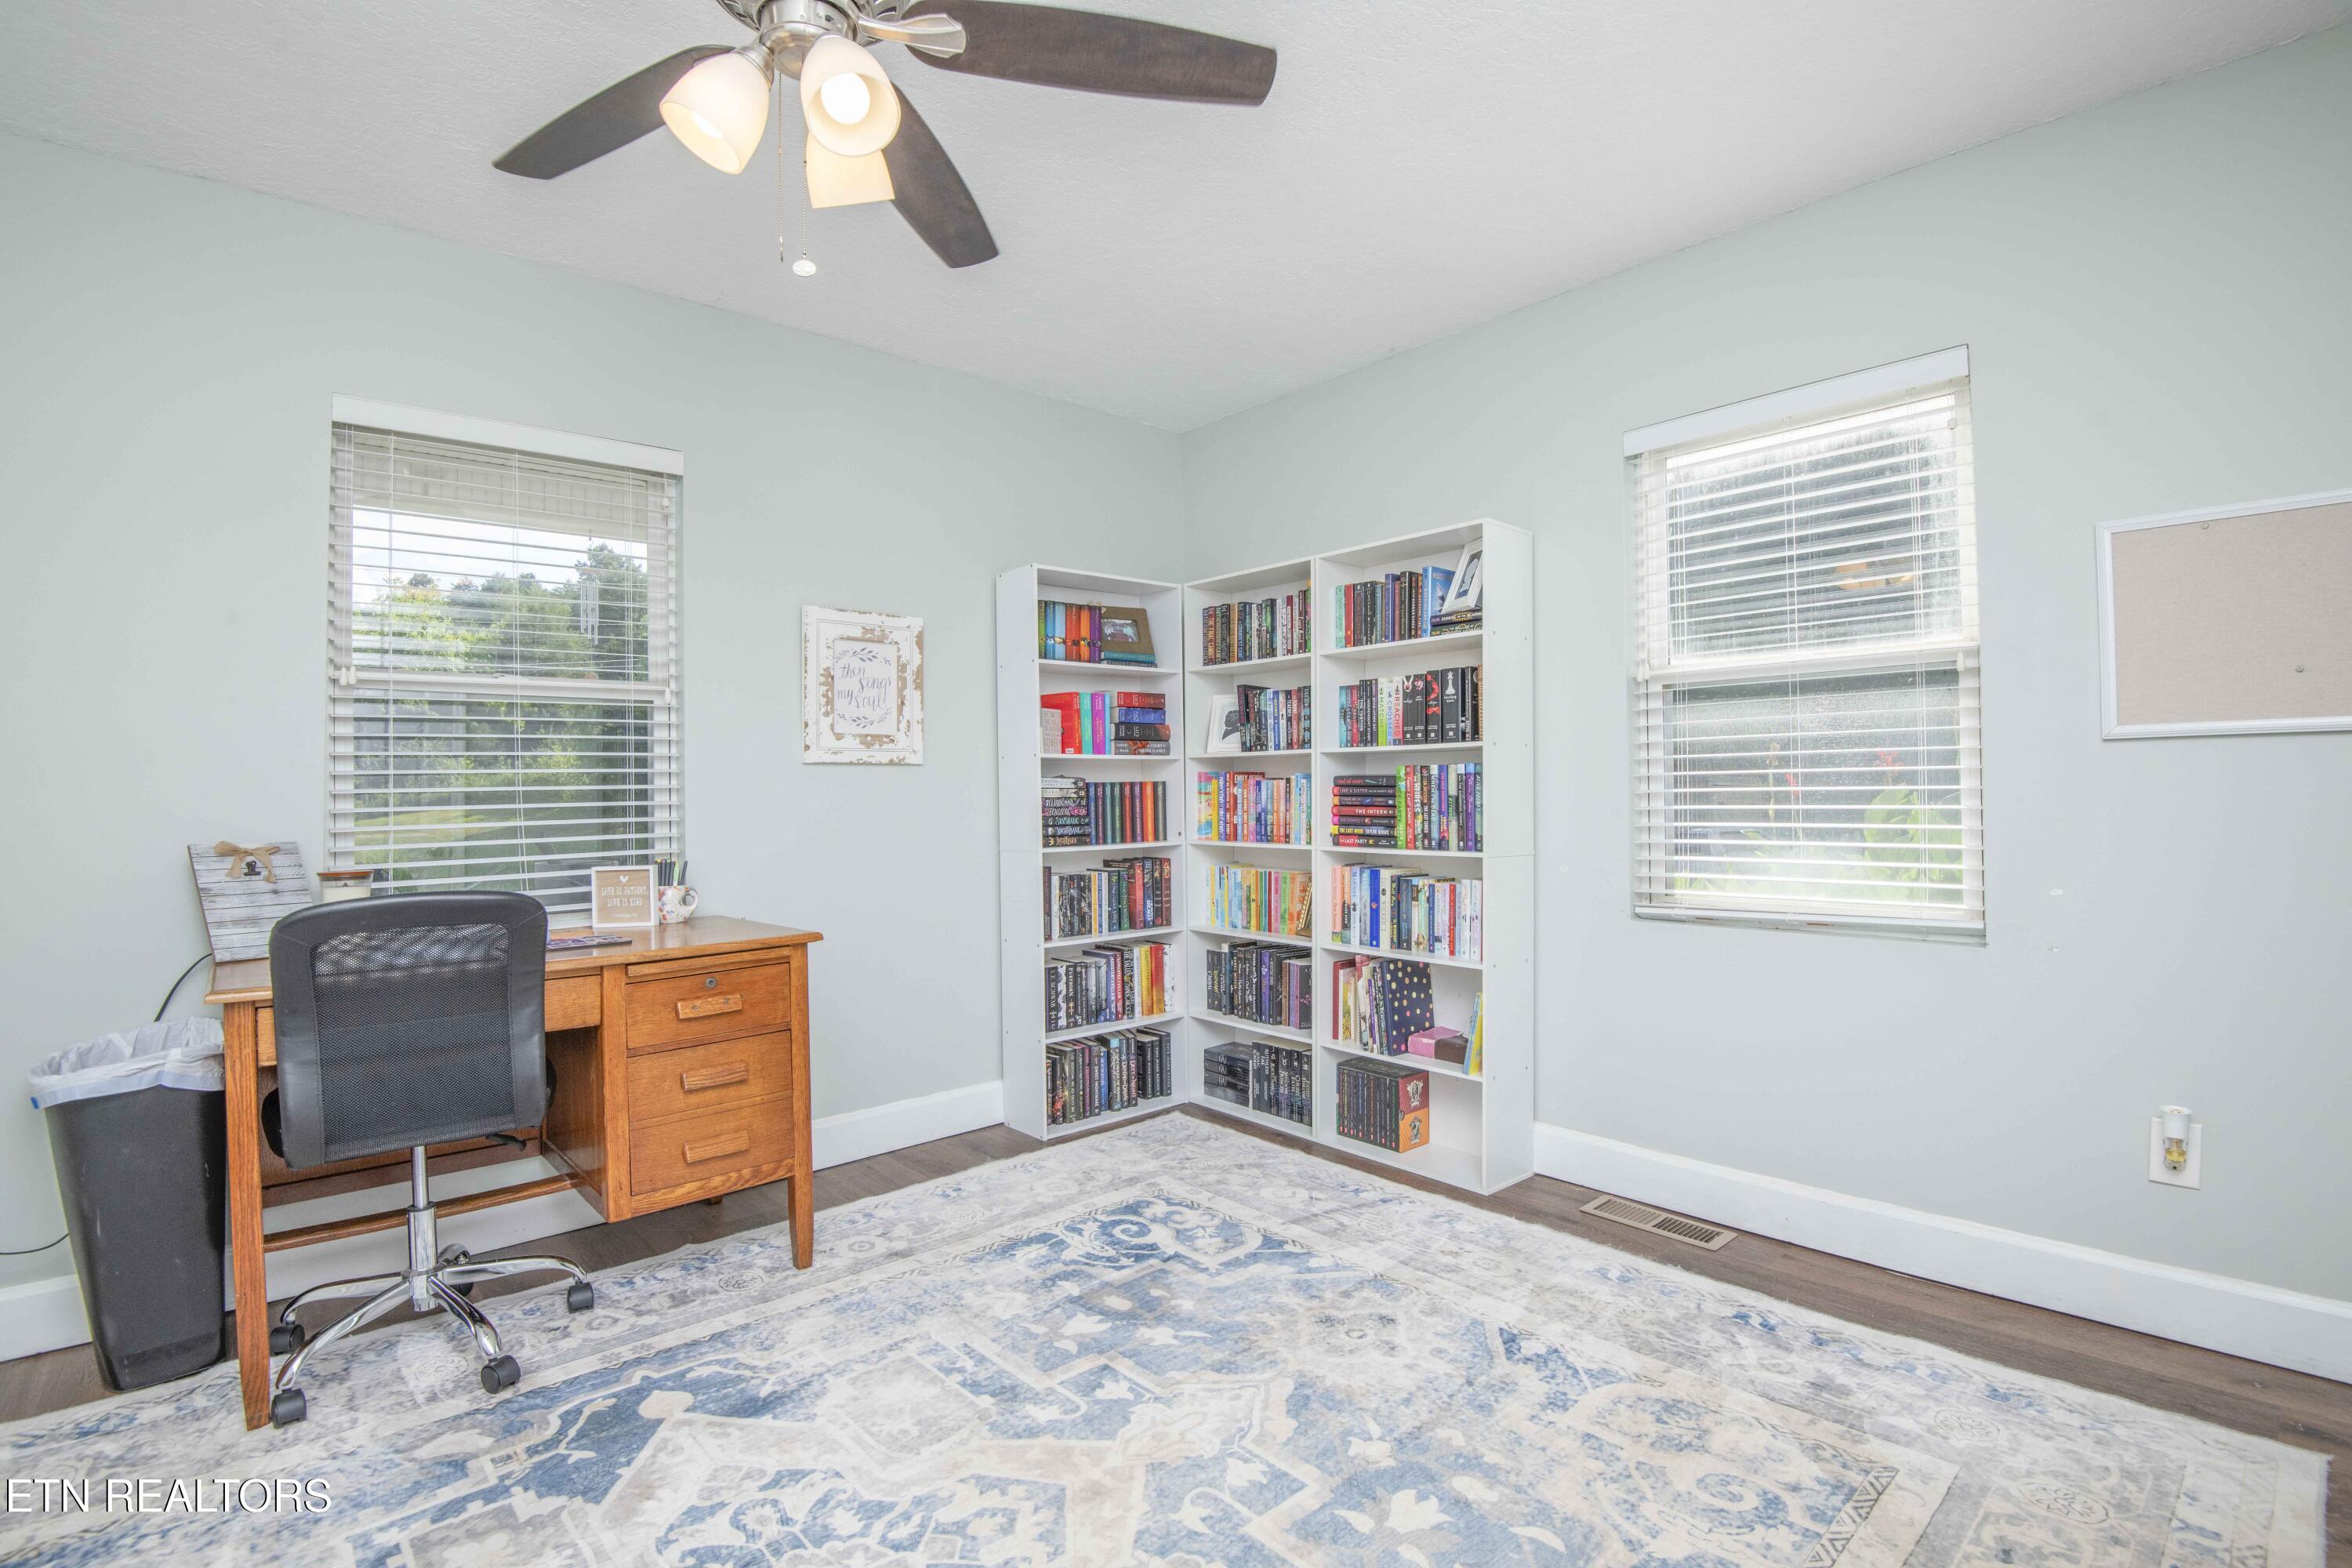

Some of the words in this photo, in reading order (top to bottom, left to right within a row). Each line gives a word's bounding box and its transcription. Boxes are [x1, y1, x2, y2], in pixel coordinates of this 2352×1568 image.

[840, 662, 866, 678] then
[837, 689, 853, 705] my
[858, 677, 891, 703] sings
[855, 688, 882, 711] soul
[602, 887, 615, 895] LOVE
[616, 886, 622, 895] IS
[607, 898, 620, 907] LOVE
[622, 897, 628, 906] IS
[630, 897, 643, 906] KIND
